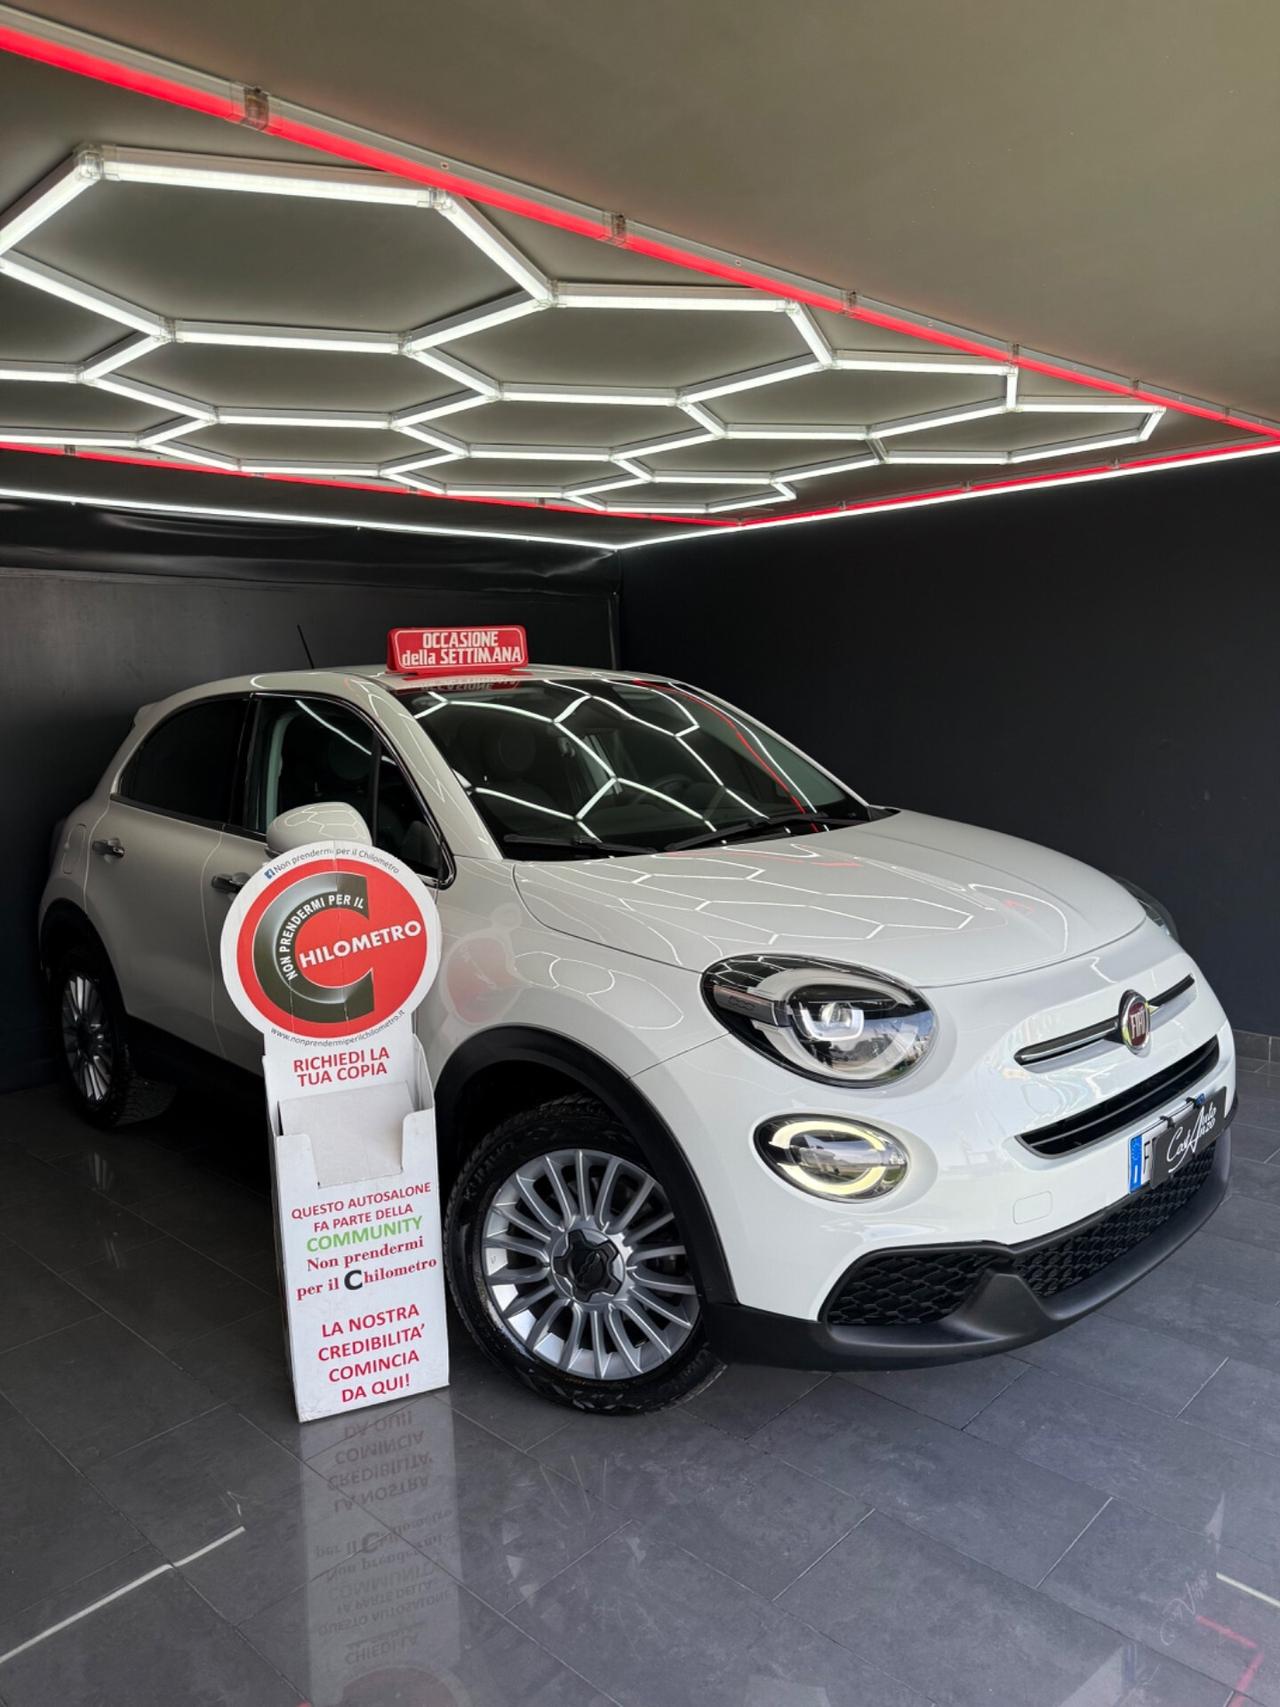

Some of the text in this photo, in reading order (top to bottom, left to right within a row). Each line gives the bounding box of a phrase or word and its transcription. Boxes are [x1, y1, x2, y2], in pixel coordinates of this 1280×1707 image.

[402, 646, 521, 666] della SETTIMANA
[423, 631, 499, 649] OCCASIONE
[273, 859, 292, 874] Non
[336, 848, 350, 856] per
[358, 850, 400, 874] Chilometro
[279, 894, 364, 981] NON PRENDERMI PER IL
[1130, 1008, 1146, 1040] FIAT
[293, 1046, 390, 1073] RICHIEDI LA
[297, 1062, 388, 1087] TUA COPIA
[291, 1182, 431, 1220] QUESTO AUTOSALONE
[313, 1203, 414, 1233] FA PARTE DELLA
[306, 1216, 423, 1253] COMMUNITY
[307, 1236, 424, 1272] Non prendermi
[296, 1258, 437, 1301] per il Chilometro
[321, 1303, 420, 1338] LA NOSTRA
[328, 1349, 420, 1382] COMINCIA
[341, 1373, 410, 1403] DA QUI!
